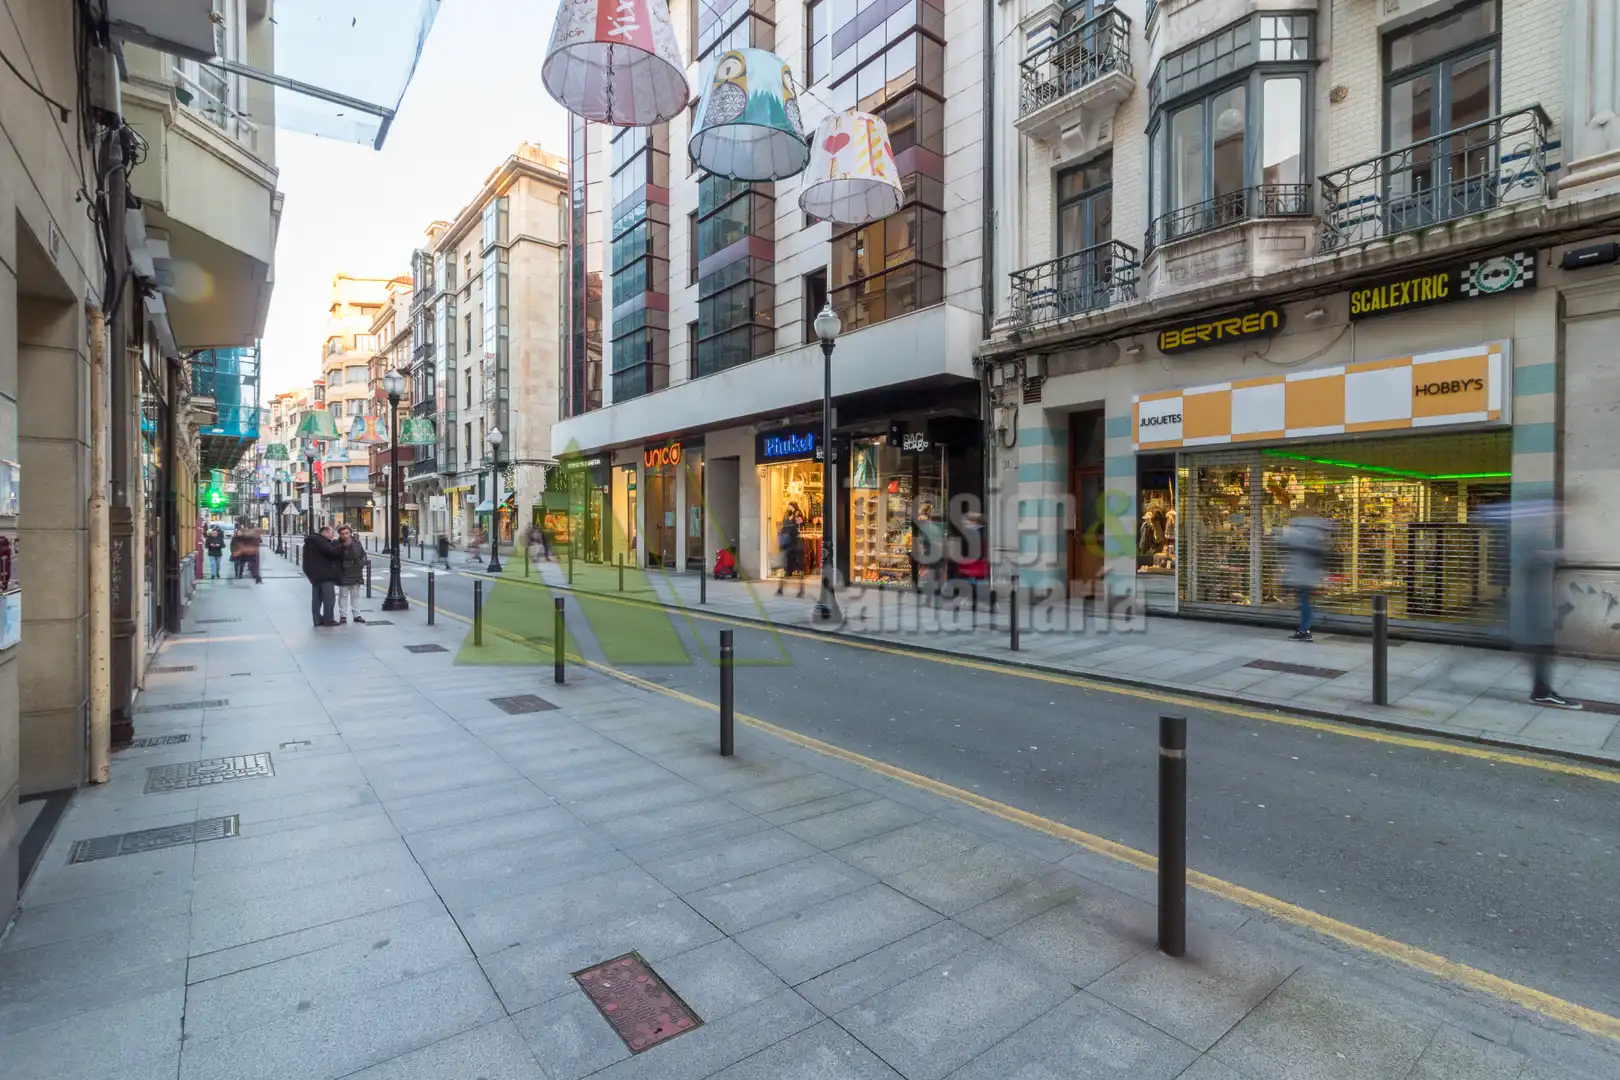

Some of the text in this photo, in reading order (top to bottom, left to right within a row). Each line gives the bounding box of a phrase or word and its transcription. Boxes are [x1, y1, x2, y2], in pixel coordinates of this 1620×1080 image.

[1351, 273, 1449, 314] SCALEXTRIC
[1415, 378, 1484, 397] HOBBY'S
[1140, 413, 1182, 428] JUGUETES
